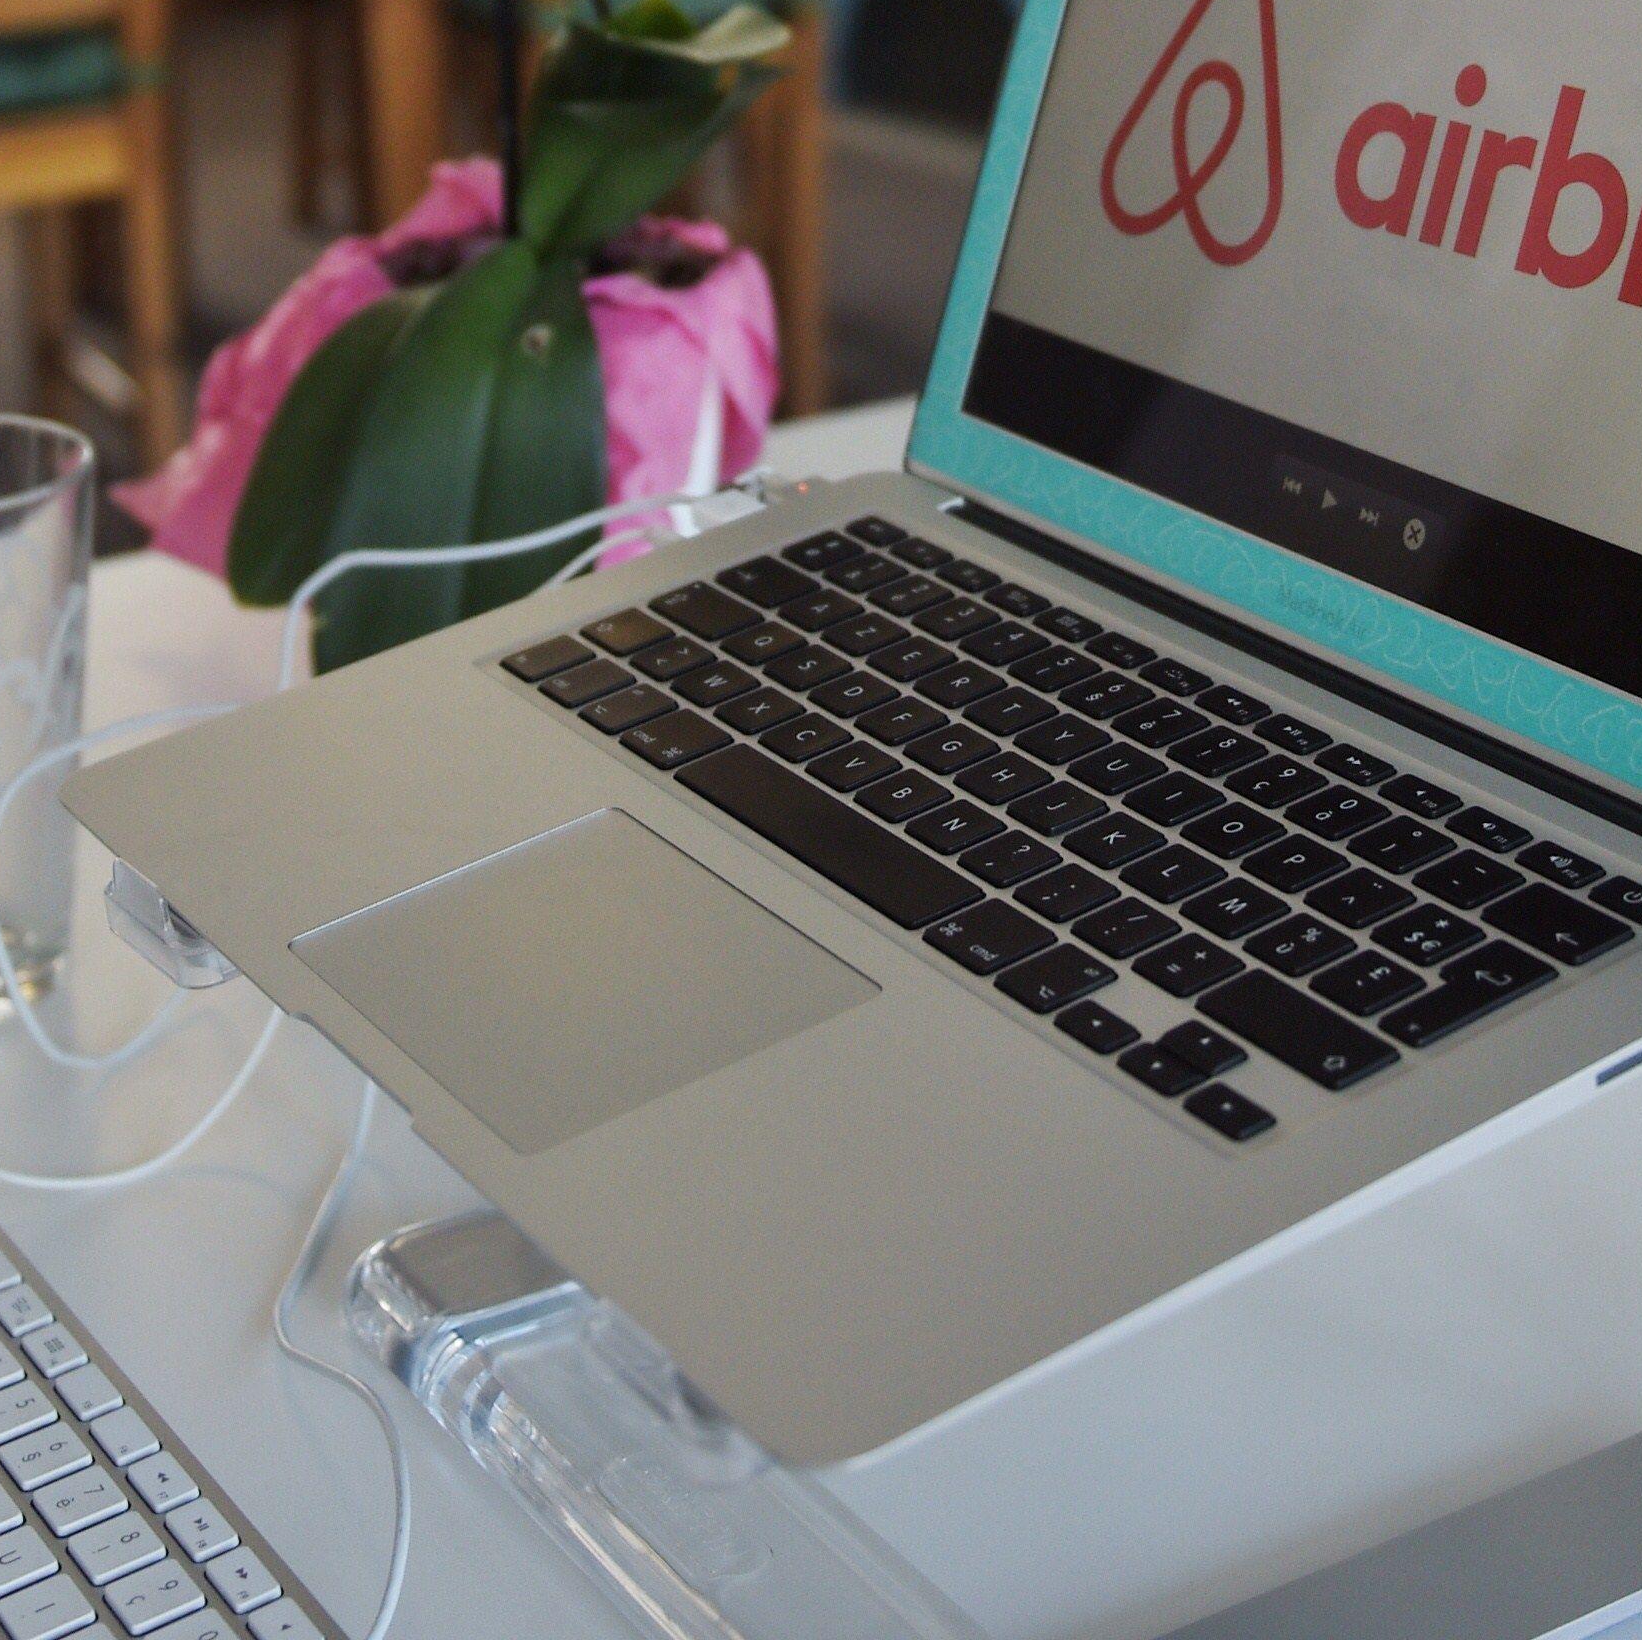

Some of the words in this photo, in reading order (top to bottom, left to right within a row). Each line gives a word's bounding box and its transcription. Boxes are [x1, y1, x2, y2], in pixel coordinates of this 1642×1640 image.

[855, 626, 877, 638] Z
[1008, 631, 1025, 642] 4
[753, 633, 775, 648] Q
[902, 650, 922, 663] E
[1057, 657, 1075, 667] 5
[797, 659, 817, 671] S
[703, 674, 729, 690] W
[950, 676, 970, 689] R
[1108, 683, 1125, 694] 6
[843, 686, 862, 698] D
[747, 701, 771, 714] X
[1002, 703, 1022, 714] T
[891, 711, 913, 723] F
[1162, 709, 1182, 720] 7
[796, 729, 817, 742] C
[1054, 730, 1075, 742] Y
[942, 740, 963, 753] G
[1218, 738, 1237, 748] 8
[845, 757, 866, 770] V
[1106, 758, 1129, 772] U
[991, 768, 1015, 783] H
[1279, 767, 1297, 779] 9
[891, 786, 913, 800] B
[1165, 790, 1183, 802] I
[1046, 801, 1067, 812] J
[942, 817, 967, 833] N
[1222, 821, 1244, 835] O
[1102, 830, 1126, 845] K
[1282, 853, 1306, 866] P
[1161, 863, 1180, 878] L
[1218, 897, 1248, 914] M
[969, 944, 999, 962] cmd
[15, 1397, 35, 1409] 5
[49, 1441, 68, 1452] 6
[84, 1484, 105, 1495] 7
[120, 1530, 141, 1544] 8
[158, 1579, 179, 1592] 9
[35, 1602, 56, 1614] I
